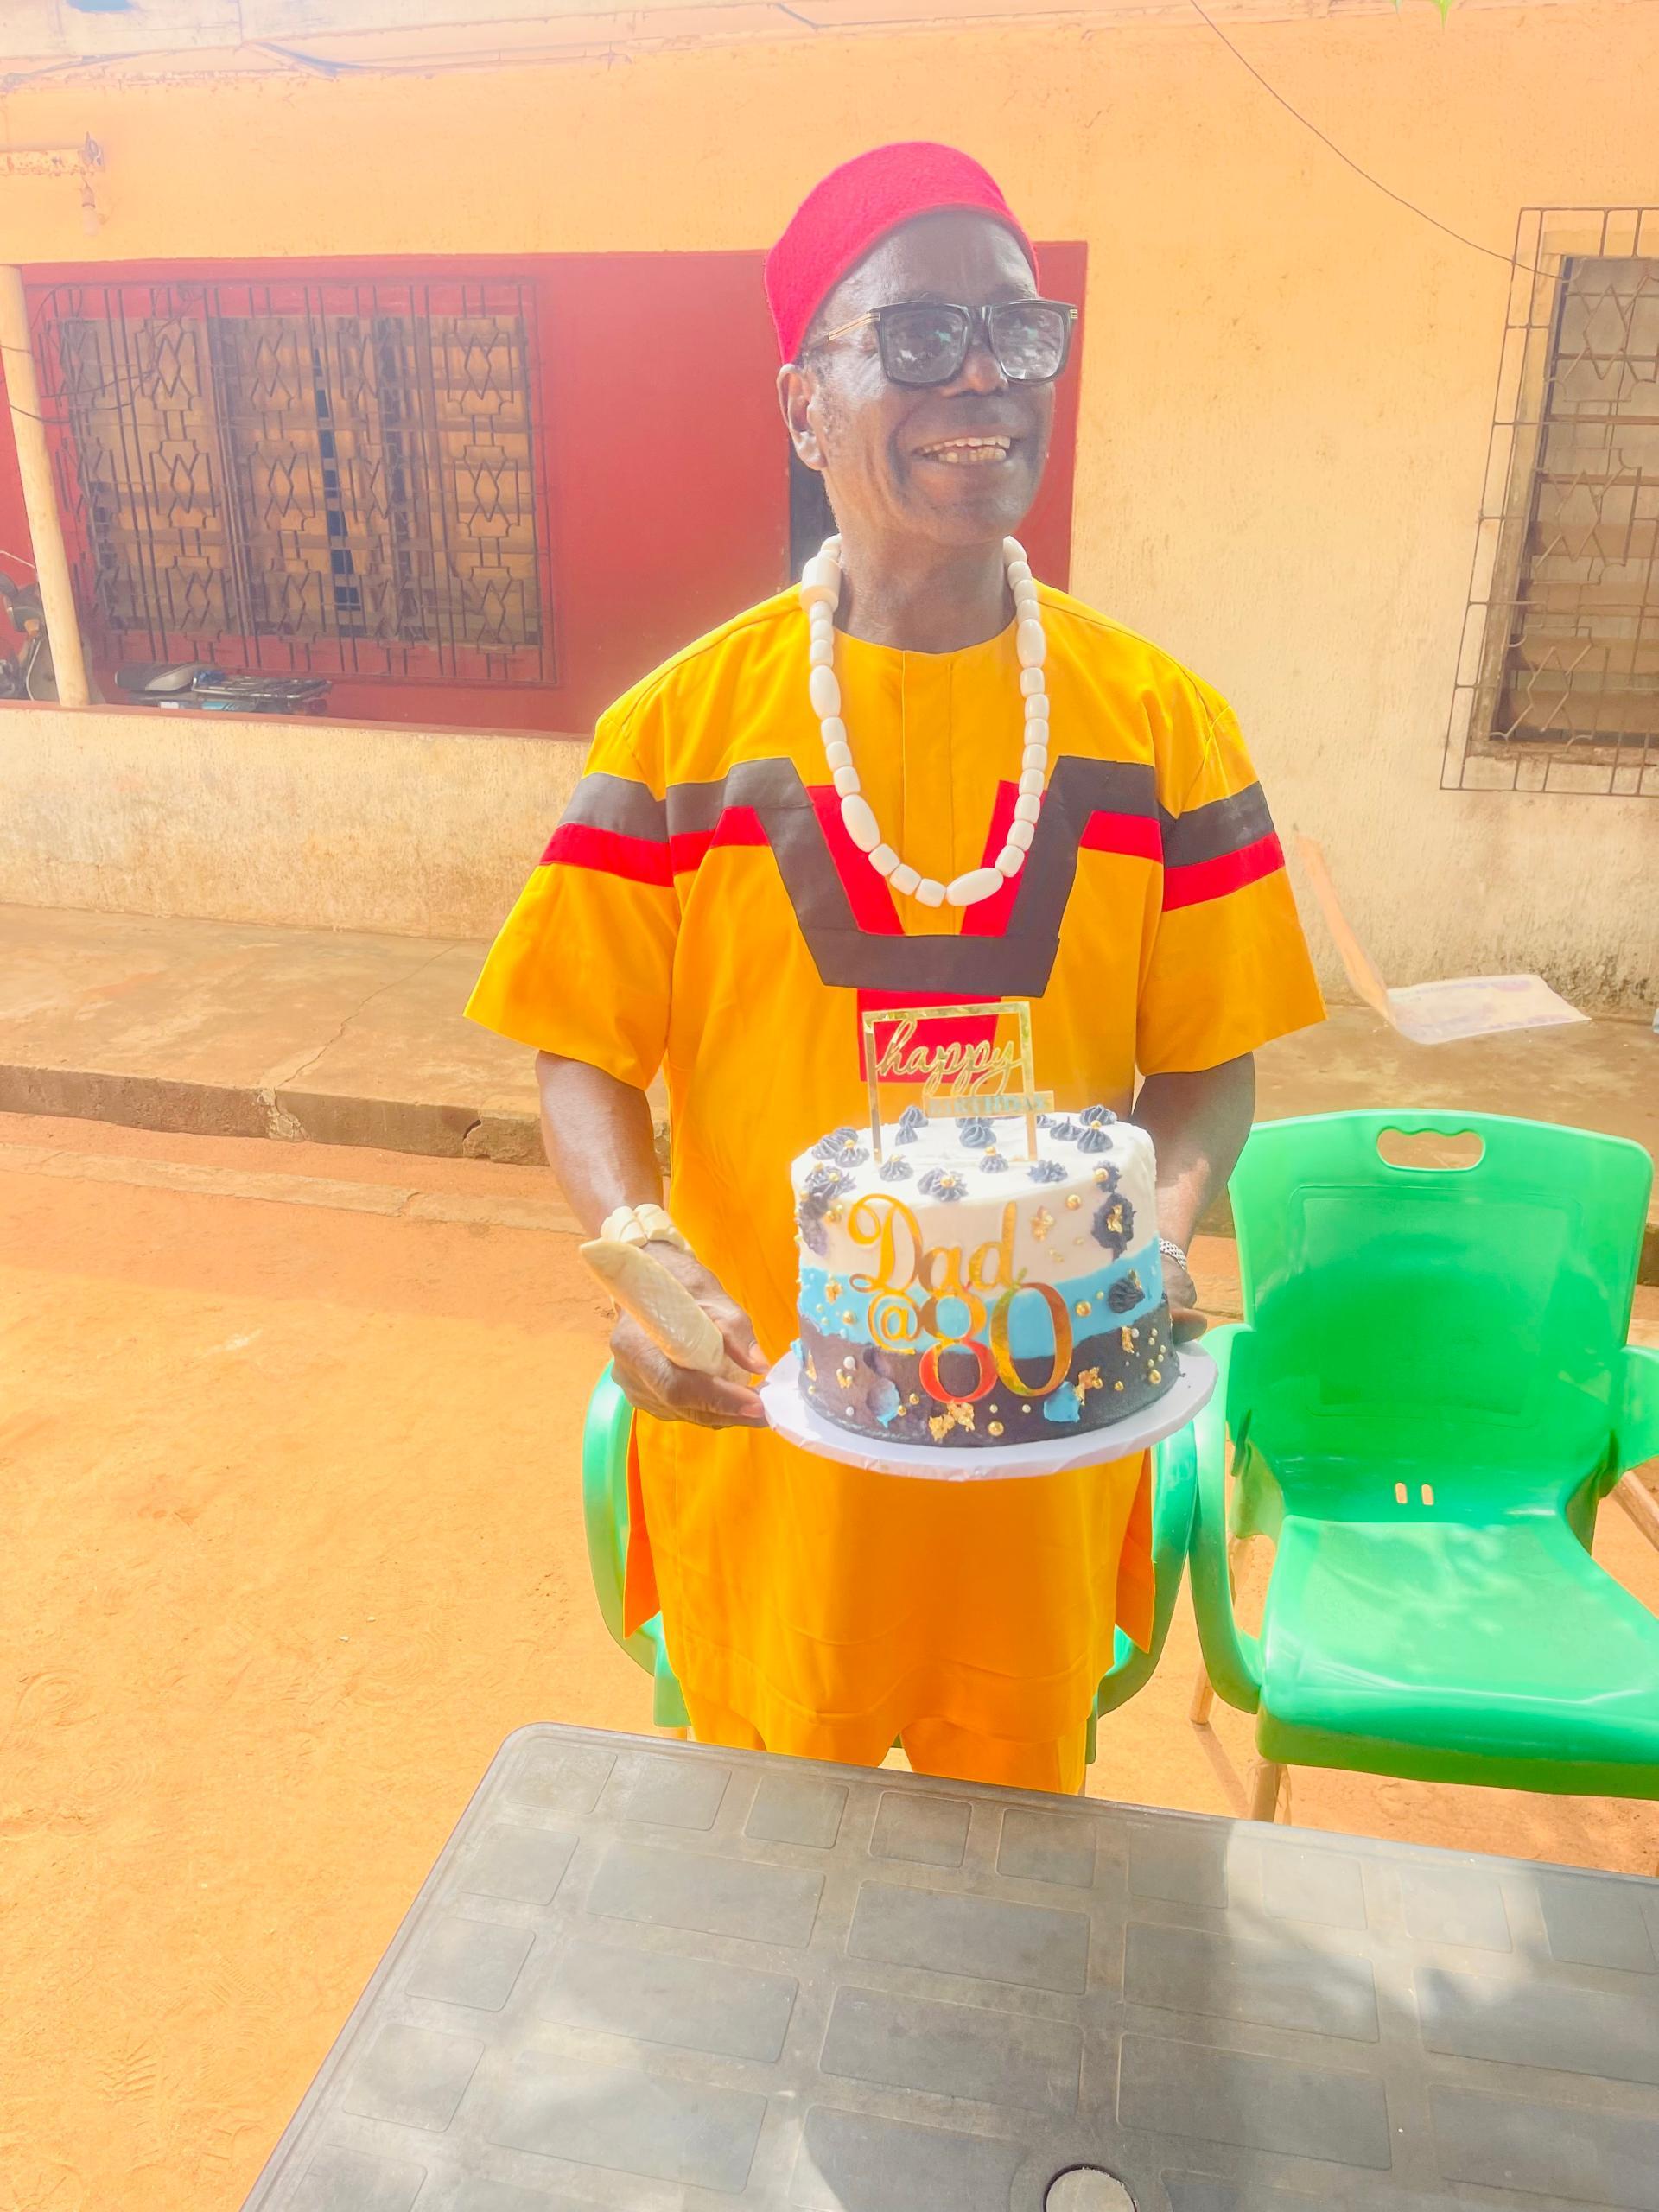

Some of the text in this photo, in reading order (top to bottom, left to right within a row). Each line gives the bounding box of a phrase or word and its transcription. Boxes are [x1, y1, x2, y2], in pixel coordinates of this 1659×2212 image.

[876, 1016, 1023, 1097] happy
[847, 1193, 1027, 1294] Dad
[868, 1282, 1073, 1403] @80
